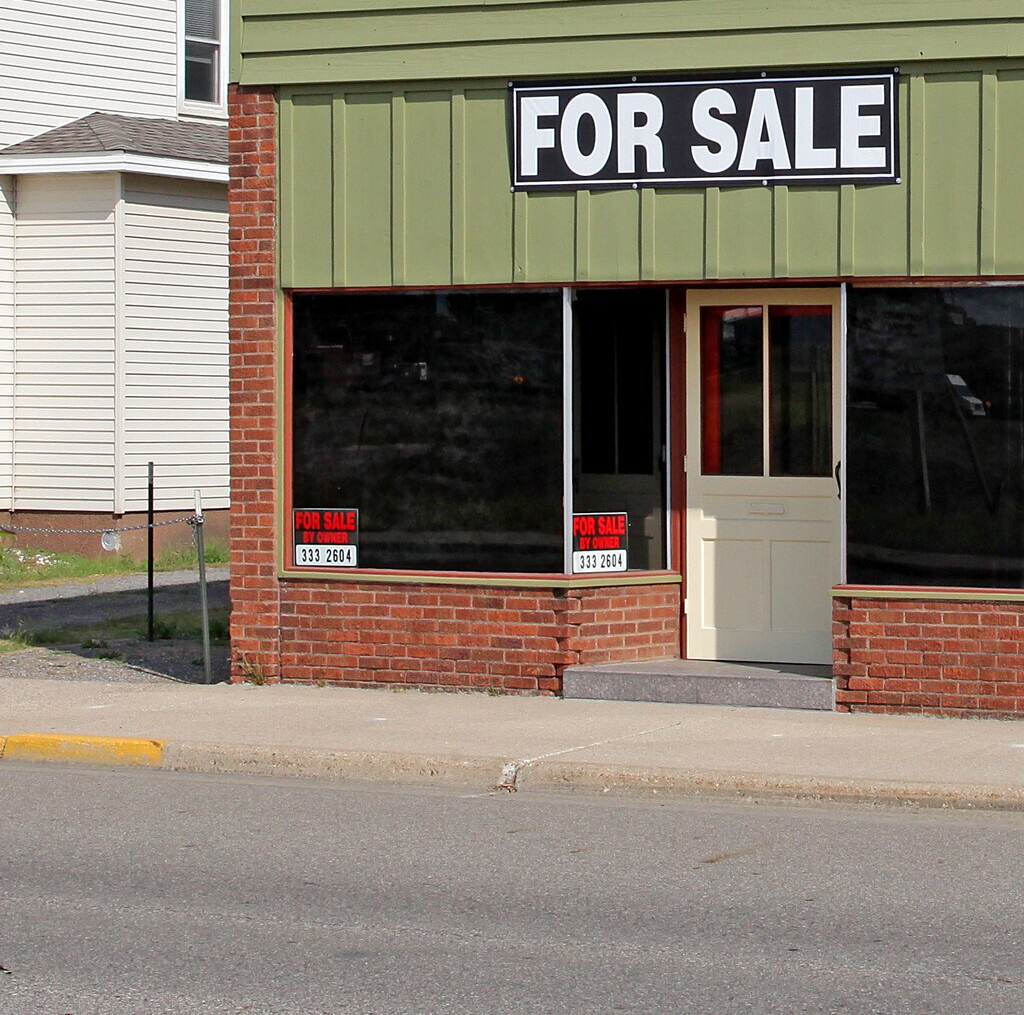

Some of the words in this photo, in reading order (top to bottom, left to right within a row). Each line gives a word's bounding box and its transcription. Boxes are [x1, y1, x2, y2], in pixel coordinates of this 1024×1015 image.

[520, 92, 665, 177] FOR
[691, 84, 886, 173] SALE
[295, 511, 321, 530] FOR
[323, 511, 356, 530] SALE
[573, 516, 596, 536] FOR
[597, 515, 626, 535] SALE
[303, 531, 315, 543] BY
[317, 531, 349, 543] OWNER
[579, 537, 591, 549] BY
[592, 536, 620, 549] OWNER
[301, 548, 321, 562] 333
[326, 548, 352, 563] 2604
[580, 554, 597, 569] 333
[600, 553, 622, 568] 2604
